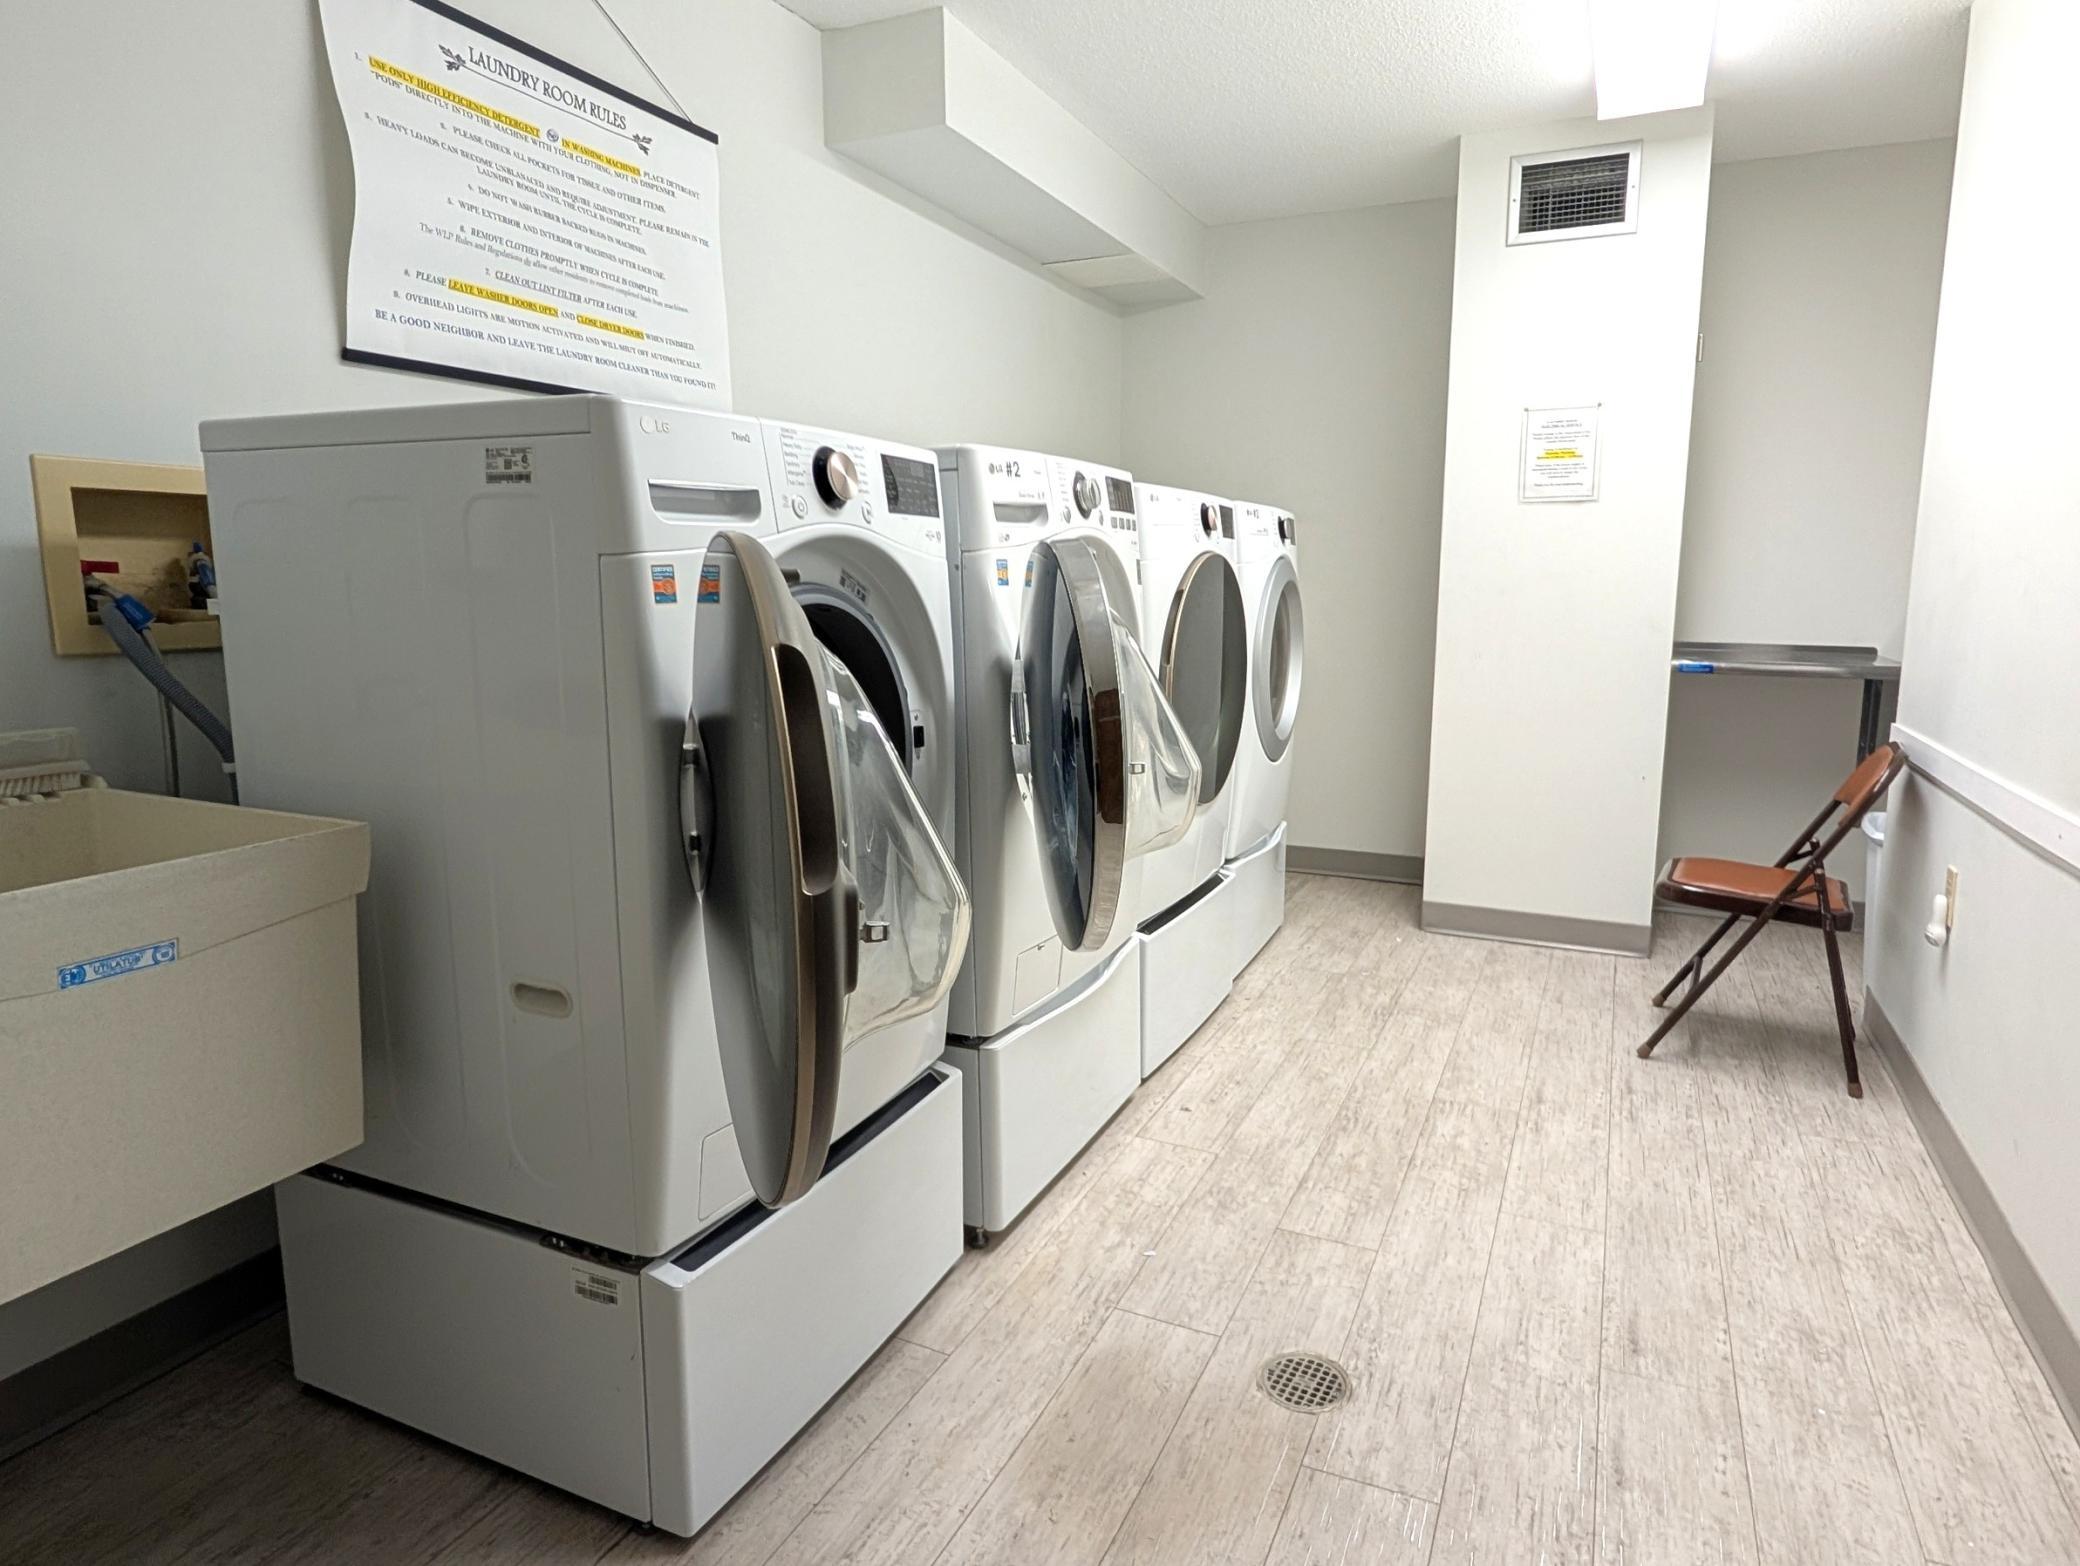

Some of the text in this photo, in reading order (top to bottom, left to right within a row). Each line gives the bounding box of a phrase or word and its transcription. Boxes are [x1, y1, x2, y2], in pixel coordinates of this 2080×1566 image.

[468, 46, 627, 130] LAUNDRY ROOM RULES
[369, 55, 388, 73] USE
[389, 66, 414, 84] ONLY
[492, 110, 540, 138] DETERGENT
[562, 138, 570, 149] IN
[571, 141, 604, 162] WASHING
[643, 171, 664, 185] PLACE
[665, 179, 700, 200] DETERGENT
[405, 84, 449, 109] DIRECTLY
[451, 105, 474, 120] INTO
[475, 114, 492, 128] THE
[493, 122, 529, 143] MACHINE
[530, 137, 552, 152] WITH
[553, 146, 574, 161] YOUR
[614, 170, 629, 182] NOT
[630, 176, 639, 185] IN
[377, 115, 409, 136] HEAVY
[410, 128, 440, 148] LOADS
[440, 142, 459, 155] CAN
[459, 148, 493, 168] BECOME
[546, 184, 561, 196] AND
[561, 189, 591, 208] REQUIRE
[639, 217, 665, 232] PLEASE
[665, 225, 691, 240] REMAIN
[698, 237, 710, 248] THE
[452, 126, 484, 145] PLEASE
[485, 139, 512, 156] CHECK
[513, 150, 526, 162] ALL
[527, 156, 561, 176] POCKETS
[561, 169, 575, 182] FOR
[576, 175, 601, 192] TISSUE
[602, 185, 616, 197] AND
[617, 191, 642, 206] OTHER
[476, 165, 514, 186] LAUNDRY
[515, 182, 538, 196] ROOM
[539, 190, 562, 205] UNTIL
[562, 200, 577, 212] THE
[577, 205, 598, 219] CYCLE
[419, 222, 433, 234] The
[474, 242, 487, 251] and
[458, 199, 480, 215] WIPE
[481, 208, 521, 229] EXTERIOR
[522, 223, 538, 235] AND
[539, 229, 574, 247] INTERIOR
[574, 240, 583, 250] OF
[584, 244, 617, 262] MACHINES
[618, 258, 636, 270] AFTER
[637, 262, 653, 275] EACH
[478, 186, 491, 197] DO
[491, 191, 508, 204] NOT
[509, 197, 533, 213] WASH
[533, 205, 561, 223] RUBBER
[561, 217, 588, 234] BACKED
[470, 227, 505, 246] REMOVE
[505, 239, 539, 257] CLOTHES
[540, 250, 579, 270] PROMPTLY
[579, 263, 600, 276] WHEN
[600, 270, 620, 283] CYCLE
[405, 292, 455, 313] OVERHEAD
[456, 304, 489, 319] LIGHTS
[490, 312, 506, 323] ARE
[507, 317, 541, 332] MOTION
[541, 326, 584, 342] ACTIVATED
[585, 335, 600, 346] AND
[600, 339, 619, 350] WILL
[619, 344, 636, 355] SHUT
[637, 349, 649, 359] OFF
[415, 270, 447, 287] PLEASE
[448, 278, 474, 296] LEAVE
[476, 286, 511, 304] WASHER
[511, 296, 538, 311] DOORS
[538, 305, 558, 317] OPEN
[560, 311, 575, 322] AND
[576, 314, 598, 328] CLOSE
[598, 320, 622, 333] DRYER
[621, 326, 645, 340] DOORS
[645, 332, 664, 344] WHEN
[495, 270, 521, 285] CLEAN
[521, 278, 537, 290] OUT
[558, 288, 582, 303] FILTER
[583, 296, 605, 309] AFTER
[606, 302, 624, 314] EACH
[375, 309, 388, 320] BE
[390, 313, 398, 323] A
[399, 314, 431, 330] GOOD
[433, 322, 485, 341] NEIGHBOR
[486, 332, 506, 345] AND
[507, 337, 536, 351] LEAVE
[536, 343, 556, 356] THE
[556, 347, 594, 364] LAUNDRY
[594, 356, 618, 369] ROOM
[618, 362, 650, 376] CLEANER
[650, 368, 669, 380] THAN
[669, 373, 683, 384] YOU
[683, 377, 707, 389] FOUND
[731, 430, 751, 443] ThinQ
[1006, 460, 1021, 478] #2
